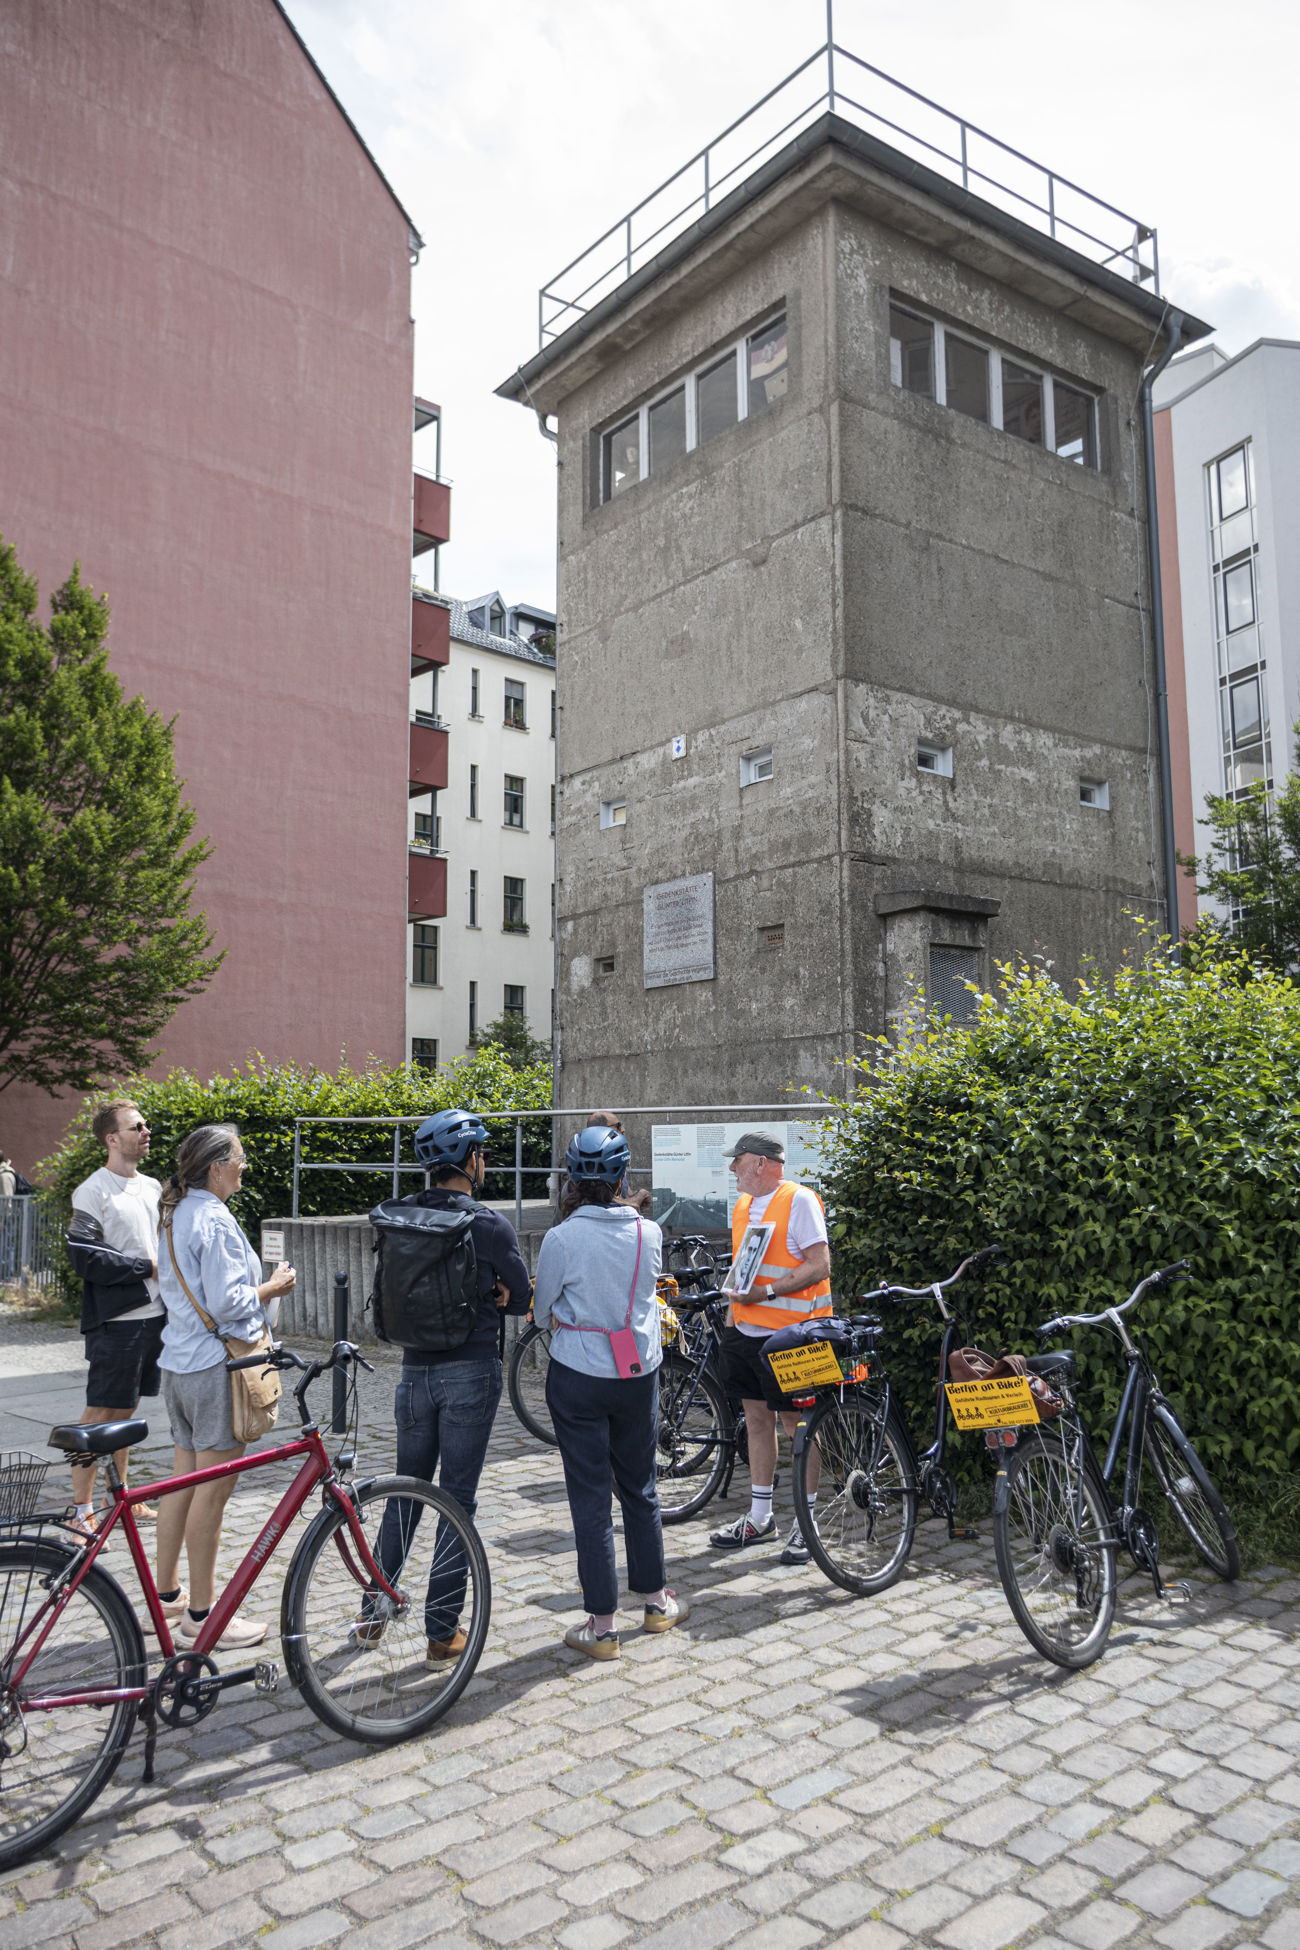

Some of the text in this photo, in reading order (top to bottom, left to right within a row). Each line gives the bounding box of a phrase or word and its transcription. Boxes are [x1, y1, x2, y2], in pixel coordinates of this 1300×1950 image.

[770, 1342, 829, 1363] Berlin on Bike!
[947, 1378, 1024, 1395] Berlin on Bike!
[251, 1525, 280, 1563] HAWK
